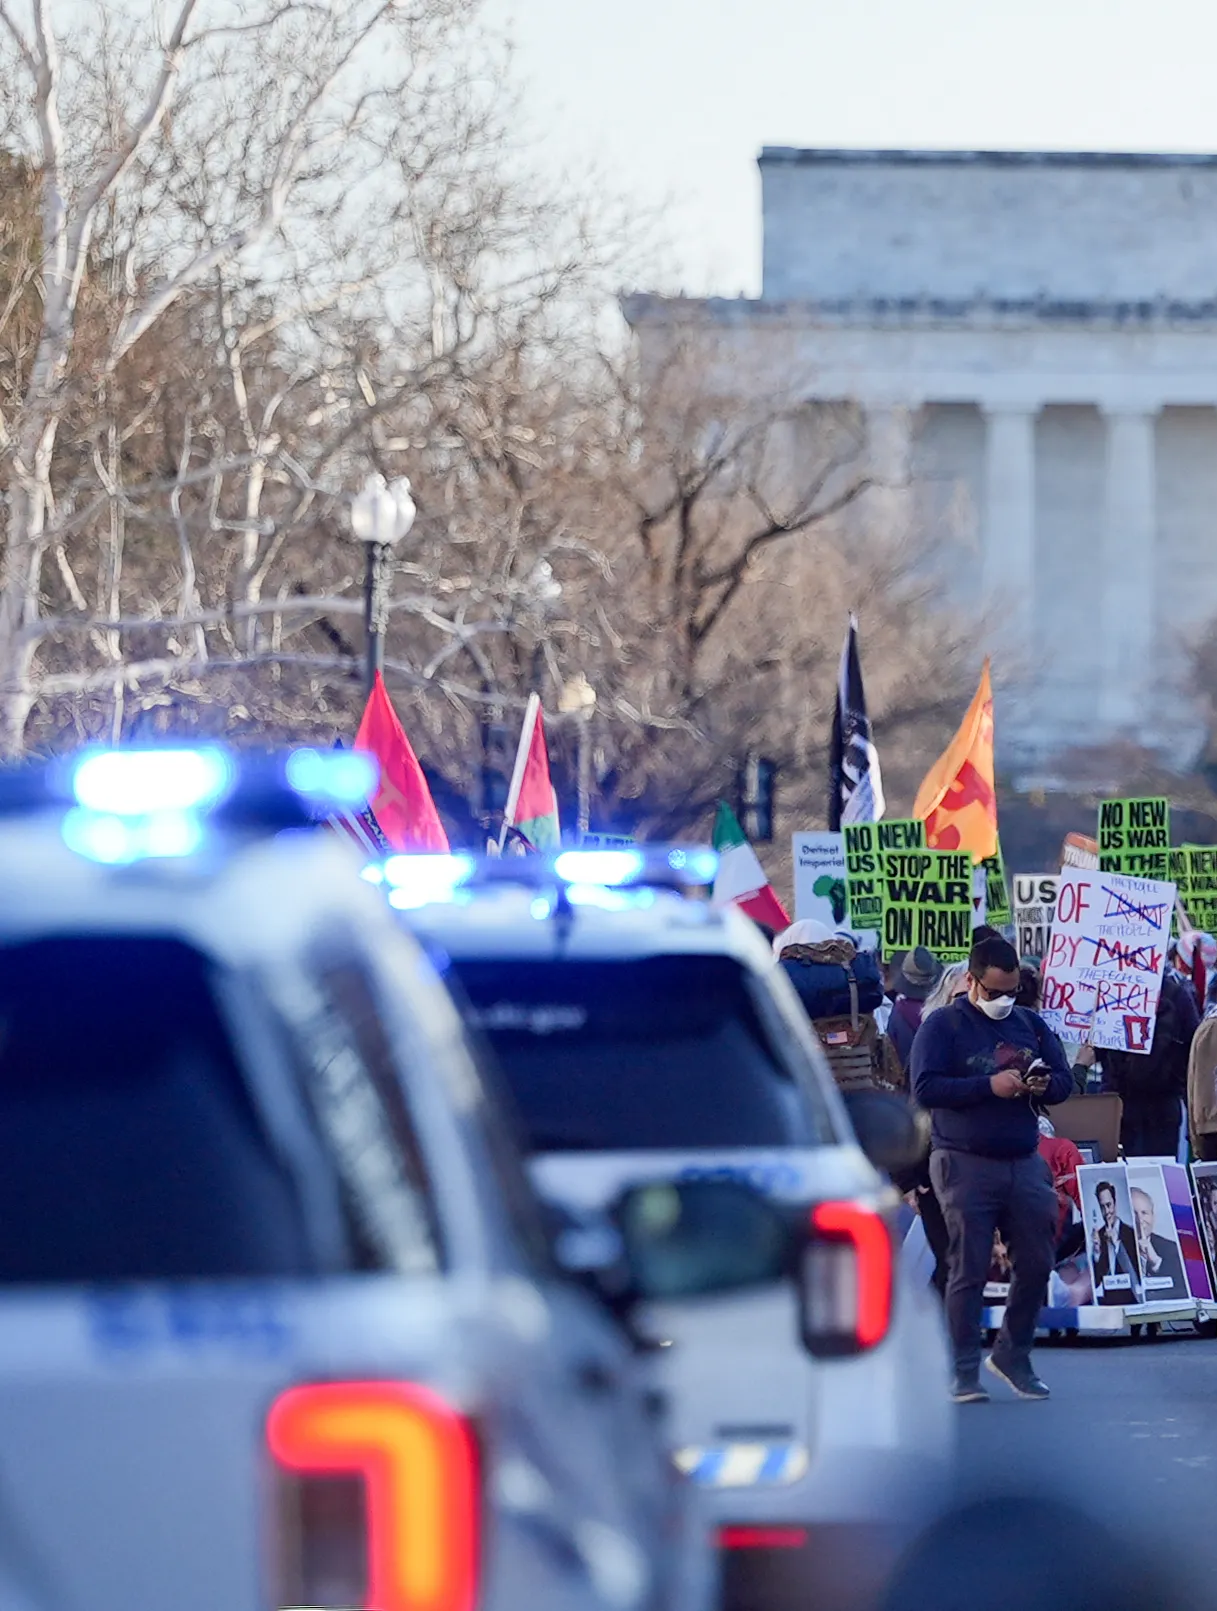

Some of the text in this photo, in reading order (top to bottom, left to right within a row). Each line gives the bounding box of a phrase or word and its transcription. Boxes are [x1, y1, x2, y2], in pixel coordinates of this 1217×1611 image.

[1101, 801, 1166, 829] NO NEW
[845, 822, 922, 853] NO NEW
[1101, 829, 1167, 850] US WAR
[800, 856, 845, 869] Imperial
[847, 854, 875, 873] US
[887, 856, 931, 879] STOP
[936, 856, 970, 879] THE
[1100, 853, 1167, 872] IN THE
[1169, 851, 1185, 875] NO
[850, 880, 874, 896] IN
[887, 881, 971, 905] WAR
[851, 897, 883, 915] MIDD
[1057, 883, 1092, 924] OF
[885, 907, 970, 948] ON IRAN!
[1050, 933, 1083, 968] BY
[1042, 976, 1075, 1013] FOR
[1096, 980, 1159, 1014] RICH
